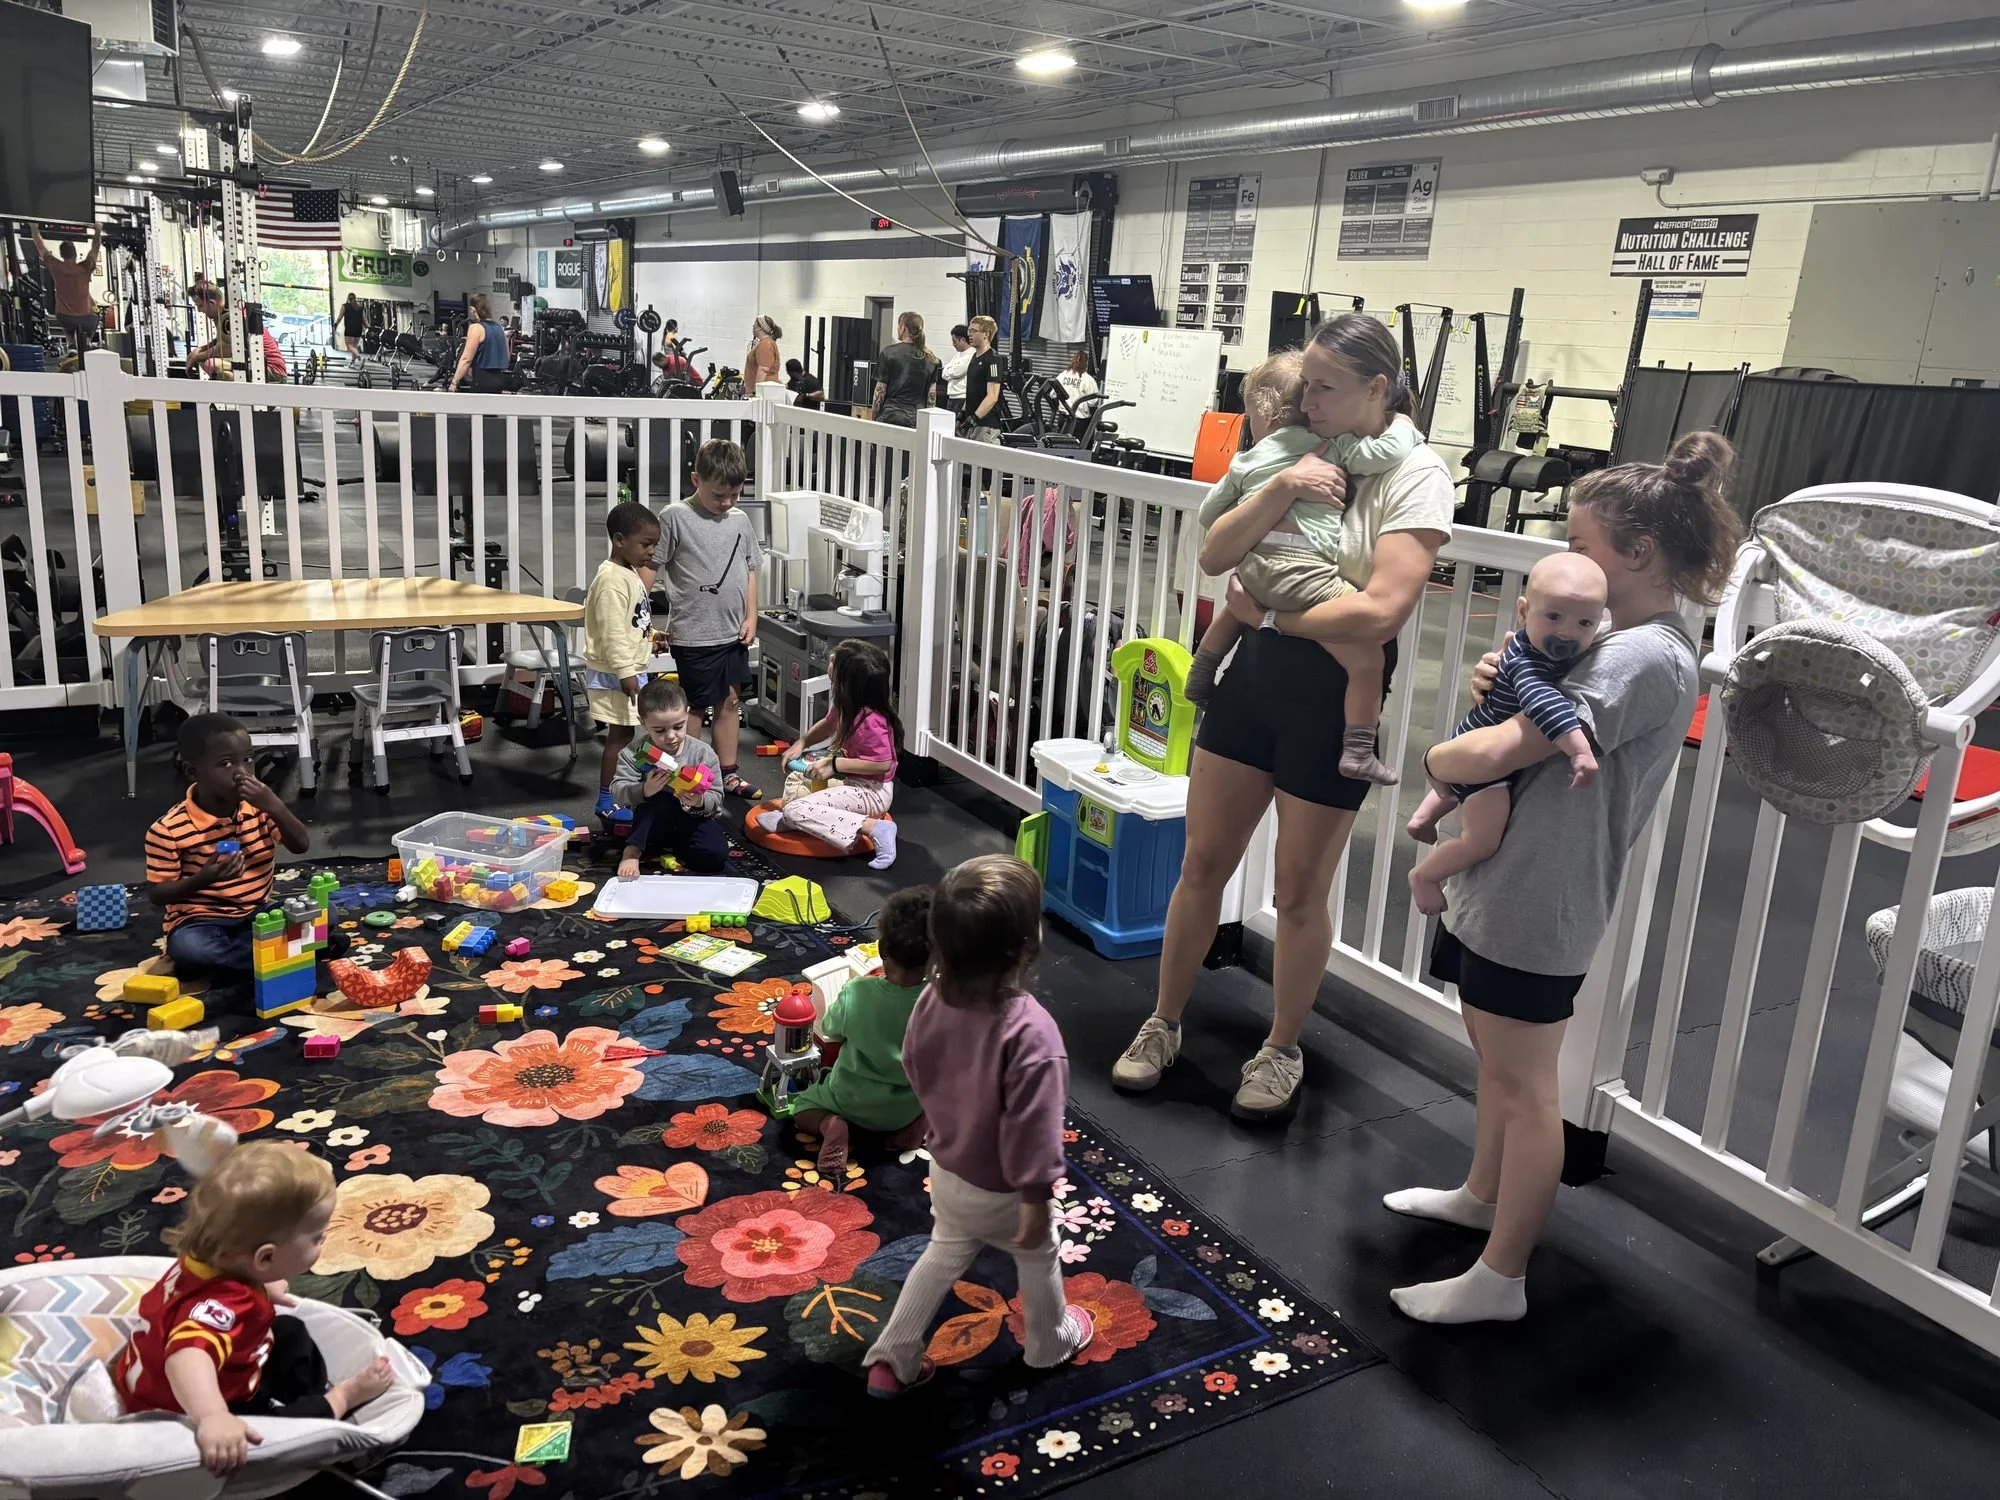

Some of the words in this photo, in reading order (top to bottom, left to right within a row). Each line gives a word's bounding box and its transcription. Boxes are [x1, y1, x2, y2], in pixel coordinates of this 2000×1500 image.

[1350, 170, 1368, 180] SILVER
[1412, 178, 1432, 196] Ag
[1242, 190, 1254, 202] Fe
[1660, 221, 1691, 230] COEFFICIENT
[1692, 219, 1718, 228] CROSSFIT
[1620, 233, 1678, 250] NUTRITION
[1681, 231, 1750, 248] CHALLENGE
[1638, 254, 1665, 270] HALL
[1669, 256, 1684, 270] OF
[1686, 253, 1720, 270] FAME
[558, 262, 581, 276] ROGUE
